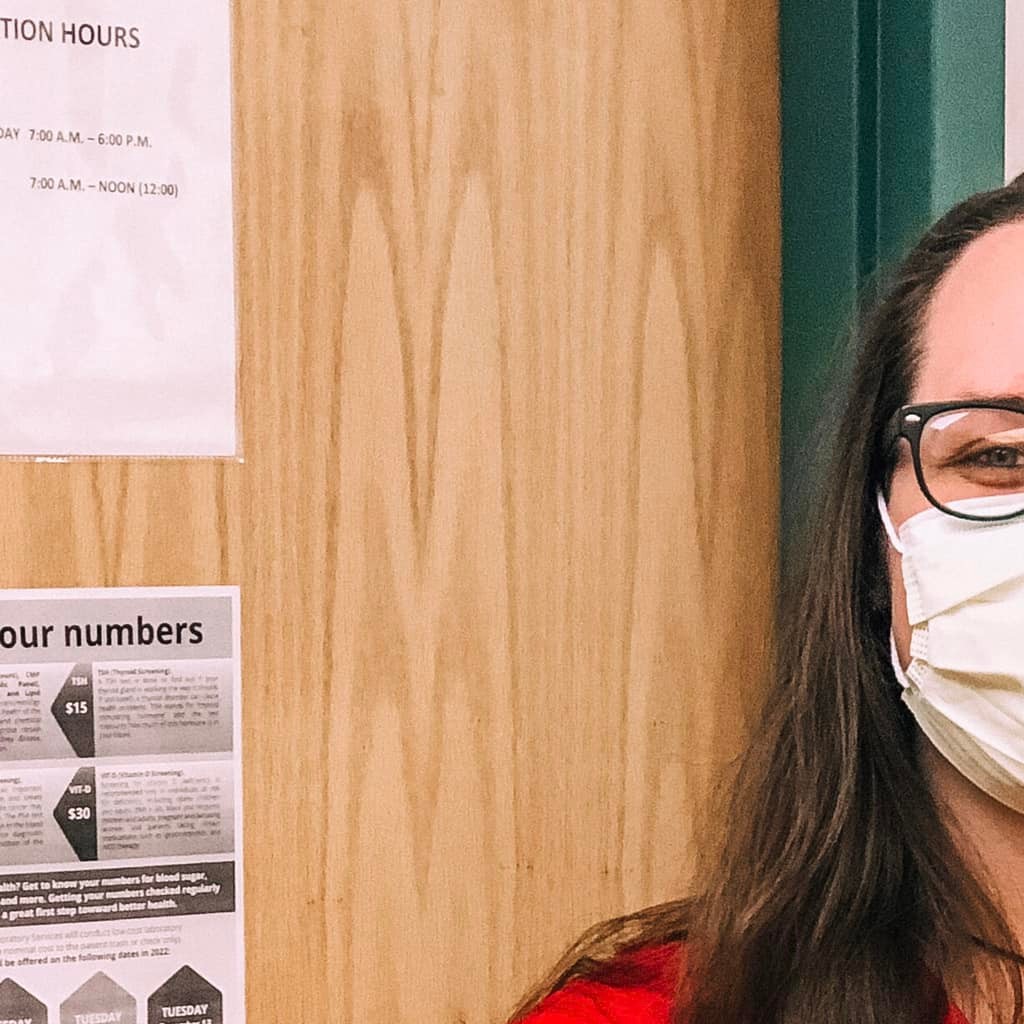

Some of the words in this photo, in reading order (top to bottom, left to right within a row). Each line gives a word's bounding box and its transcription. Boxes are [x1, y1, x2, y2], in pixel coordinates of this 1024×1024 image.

[0, 17, 54, 42] TION
[61, 22, 141, 49] HOURS
[29, 129, 54, 142] 7:00
[56, 131, 85, 144] A.M.
[97, 133, 123, 146] 6:00
[126, 135, 153, 148] P.M.
[30, 177, 55, 190] 7:00
[57, 179, 86, 192] A.M.
[98, 181, 136, 194] NOON
[138, 183, 179, 198] (12:00)
[0, 623, 54, 649] our
[64, 615, 204, 648] numbers
[65, 701, 88, 715] $15
[68, 807, 91, 821] $30
[162, 1003, 209, 1018] TUESDAY
